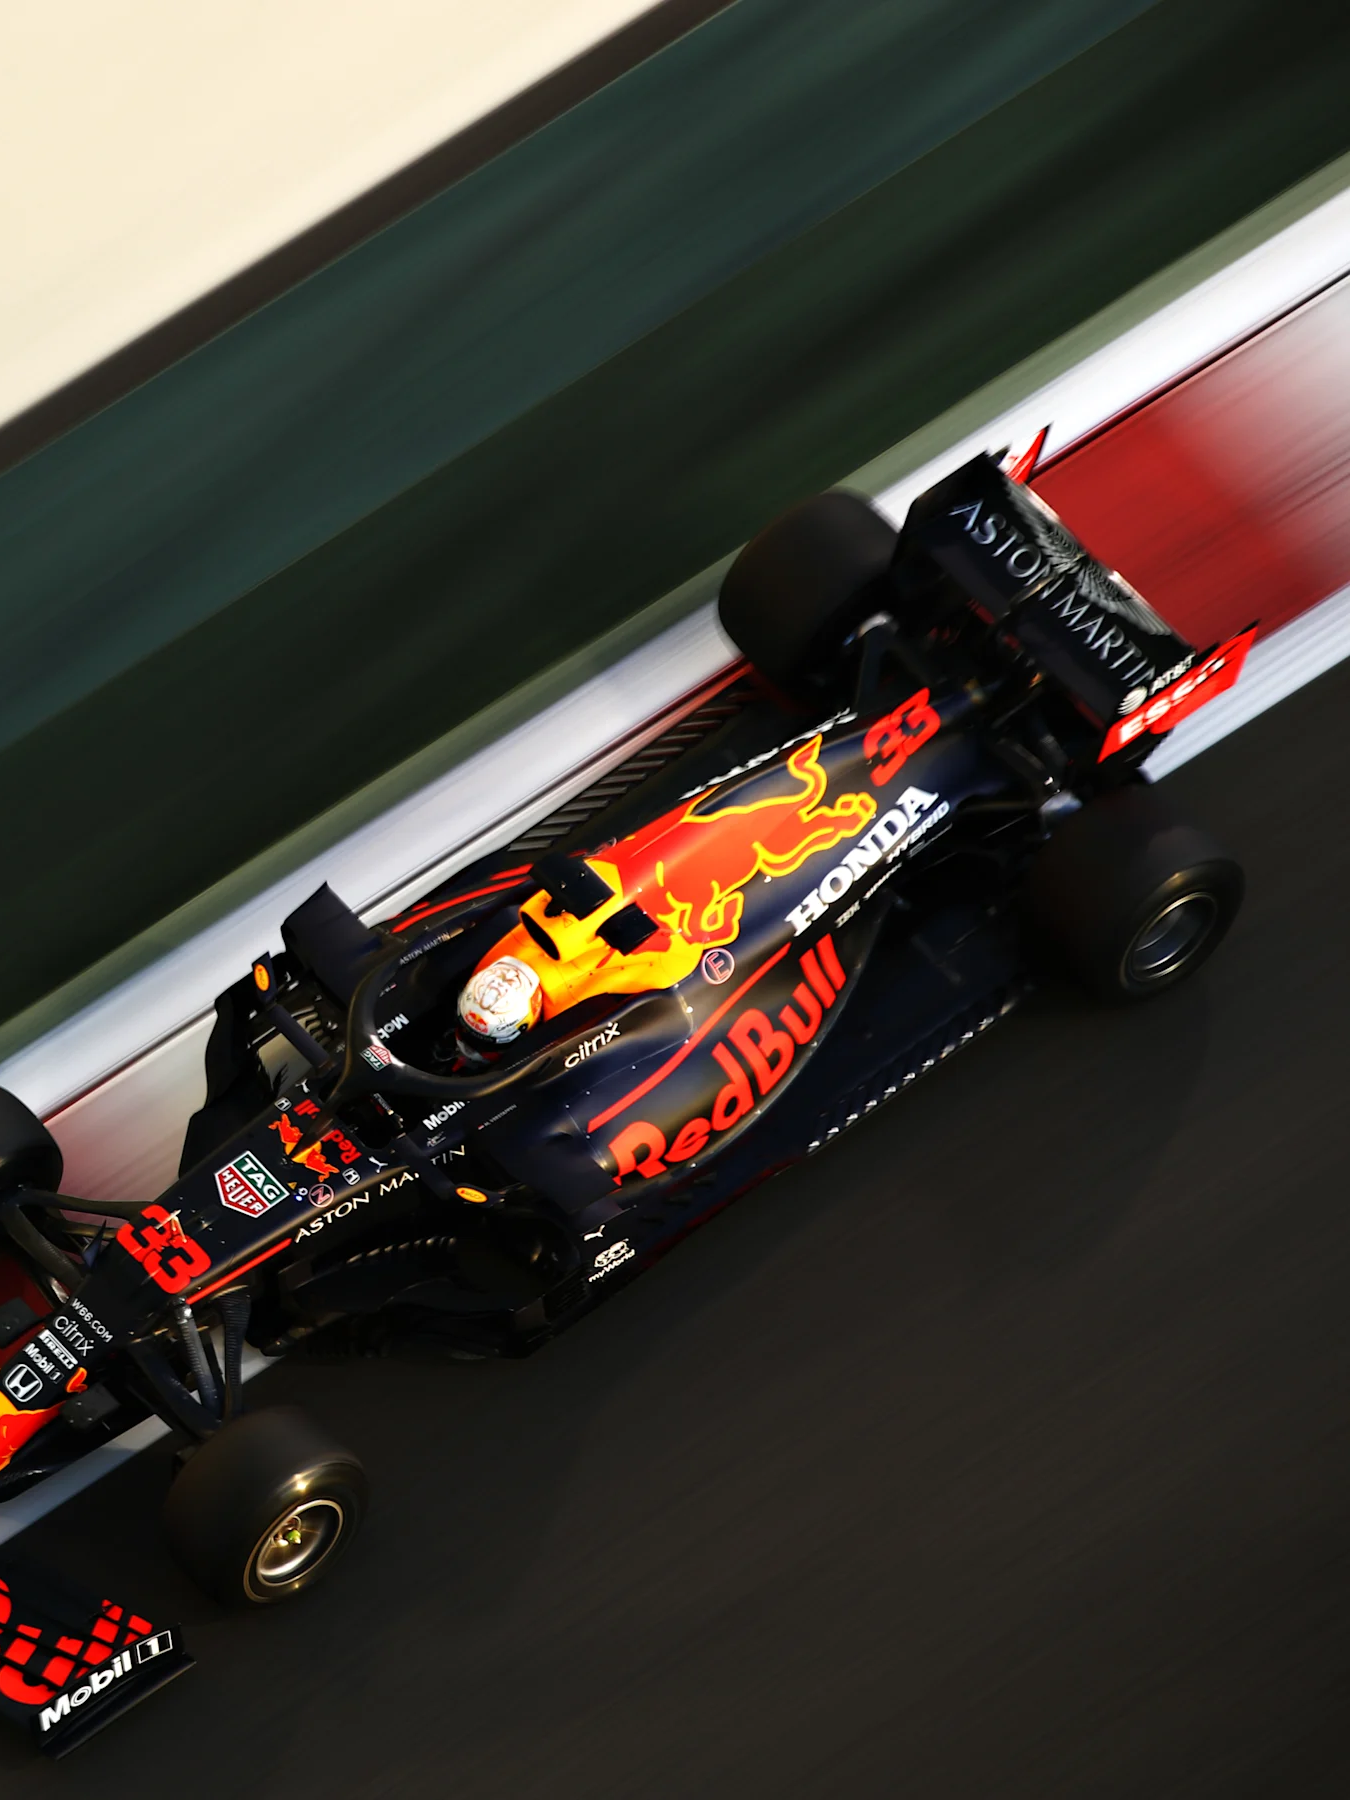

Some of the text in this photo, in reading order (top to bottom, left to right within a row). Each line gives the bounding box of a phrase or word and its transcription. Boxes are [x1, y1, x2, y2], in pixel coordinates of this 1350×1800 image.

[863, 687, 941, 787] 33
[886, 800, 950, 864] HYBRID
[785, 786, 939, 937] HONDA
[399, 948, 423, 966] ASTON
[377, 1013, 410, 1040] Mob
[564, 1022, 621, 1069] citrix
[363, 1048, 382, 1069] TAG
[221, 1168, 264, 1213] HEUER
[240, 1155, 282, 1200] TAG
[295, 1145, 466, 1243] ASTON MATIN
[116, 1204, 211, 1294] 33
[588, 1248, 636, 1283] myWorld
[71, 1298, 114, 1343] W66.COM
[23, 1343, 55, 1376] Mobil
[38, 1329, 78, 1370] PIRELLI
[38, 1650, 133, 1732] Mobil
